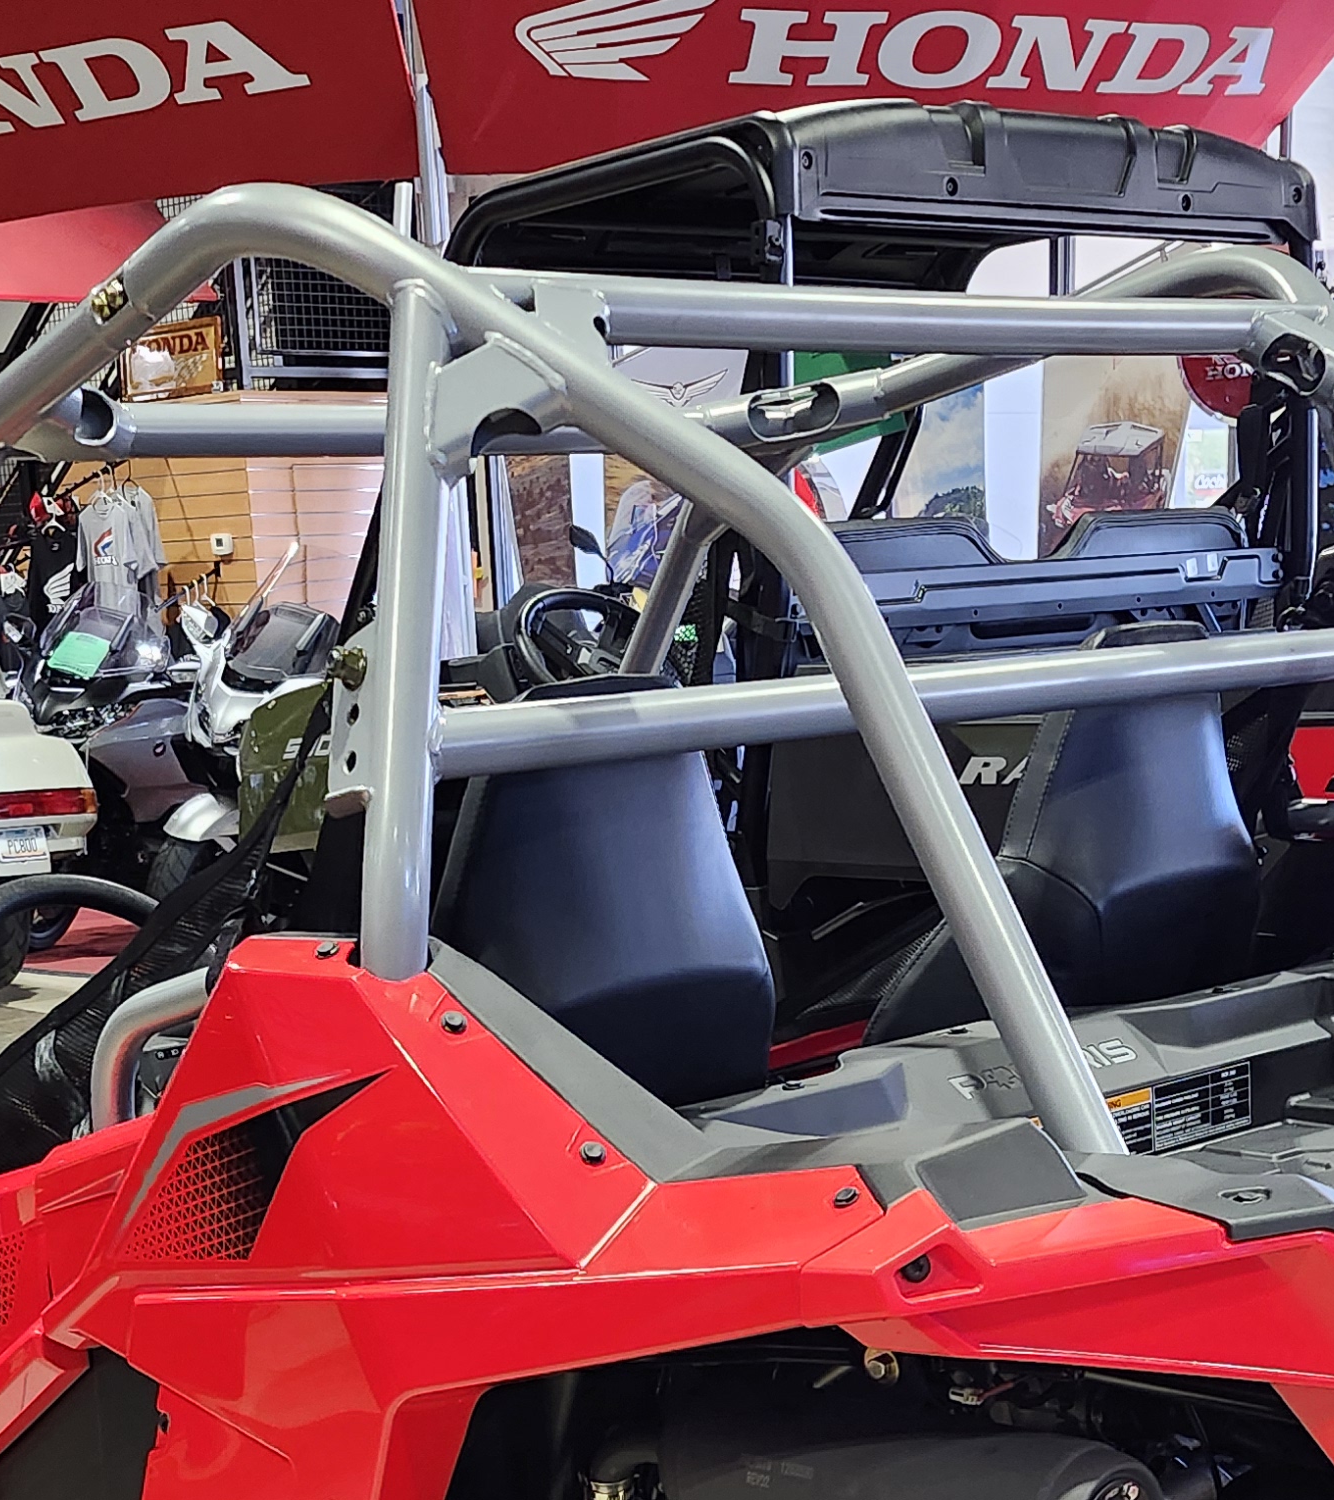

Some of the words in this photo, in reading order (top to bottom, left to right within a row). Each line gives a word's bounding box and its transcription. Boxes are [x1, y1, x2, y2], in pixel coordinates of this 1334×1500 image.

[728, 9, 1274, 96] HONDA
[1205, 362, 1254, 380] HON
[7, 837, 38, 855] PC800
